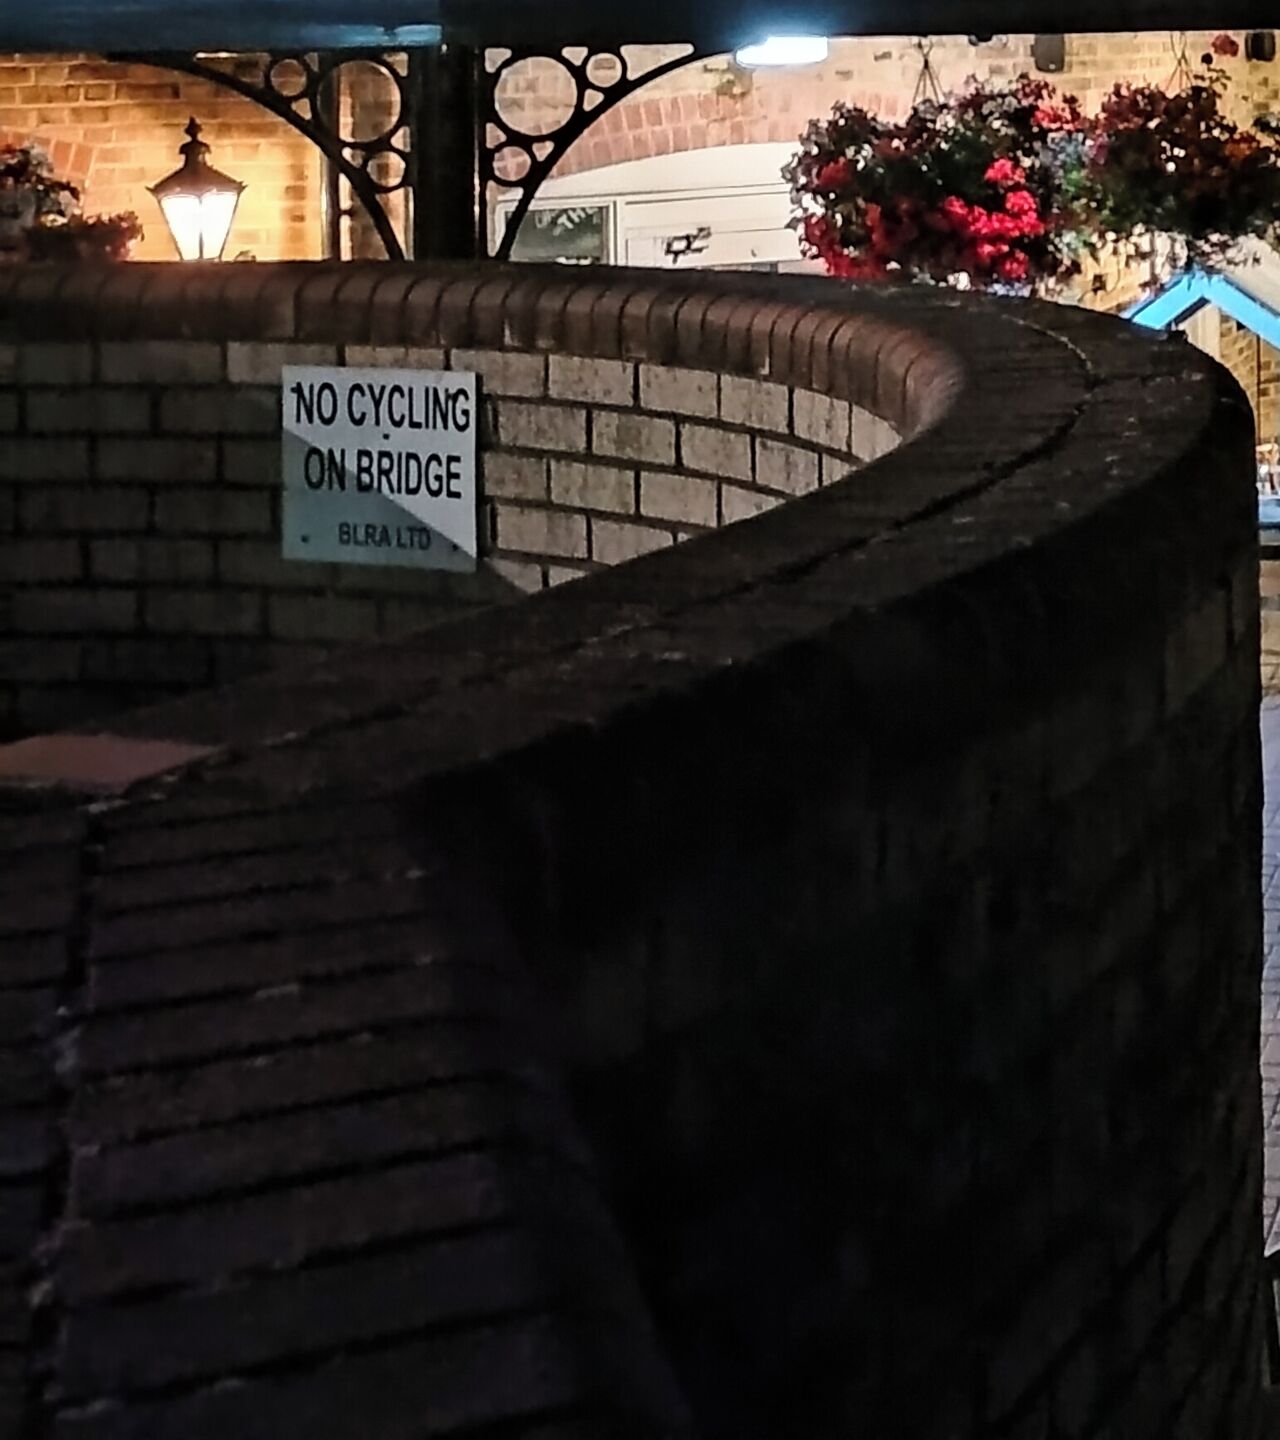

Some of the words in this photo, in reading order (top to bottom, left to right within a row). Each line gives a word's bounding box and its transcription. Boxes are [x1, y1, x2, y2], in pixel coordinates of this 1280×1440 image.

[295, 382, 337, 426] NO
[347, 383, 470, 433] CYCLING
[304, 447, 346, 491] ON
[356, 449, 462, 499] BRIDGE
[338, 522, 392, 548] BLRA
[396, 526, 432, 551] LTD
